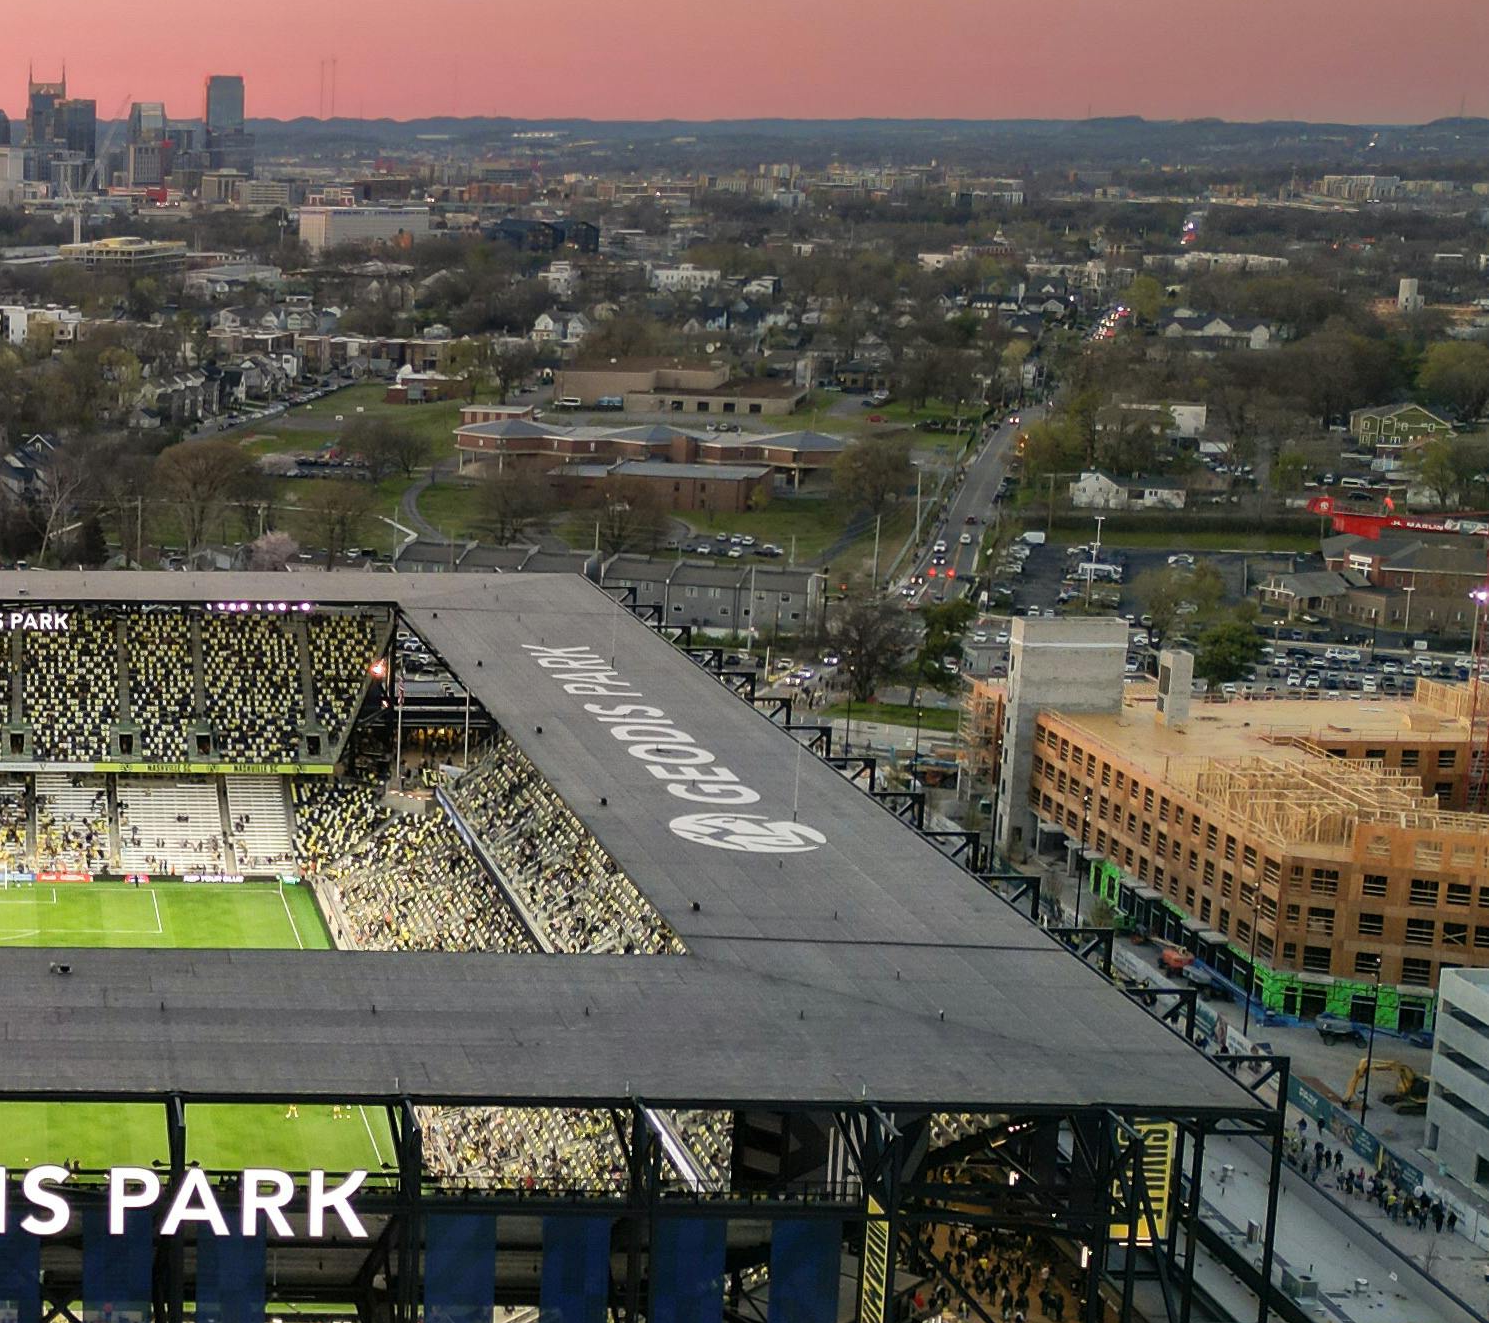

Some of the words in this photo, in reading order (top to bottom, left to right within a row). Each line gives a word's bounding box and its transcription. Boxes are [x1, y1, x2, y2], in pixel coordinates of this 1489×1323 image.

[11, 612, 69, 630] PARK
[520, 644, 643, 697] PARK
[584, 703, 761, 805] GEODIS
[111, 1167, 369, 1239] PARK
